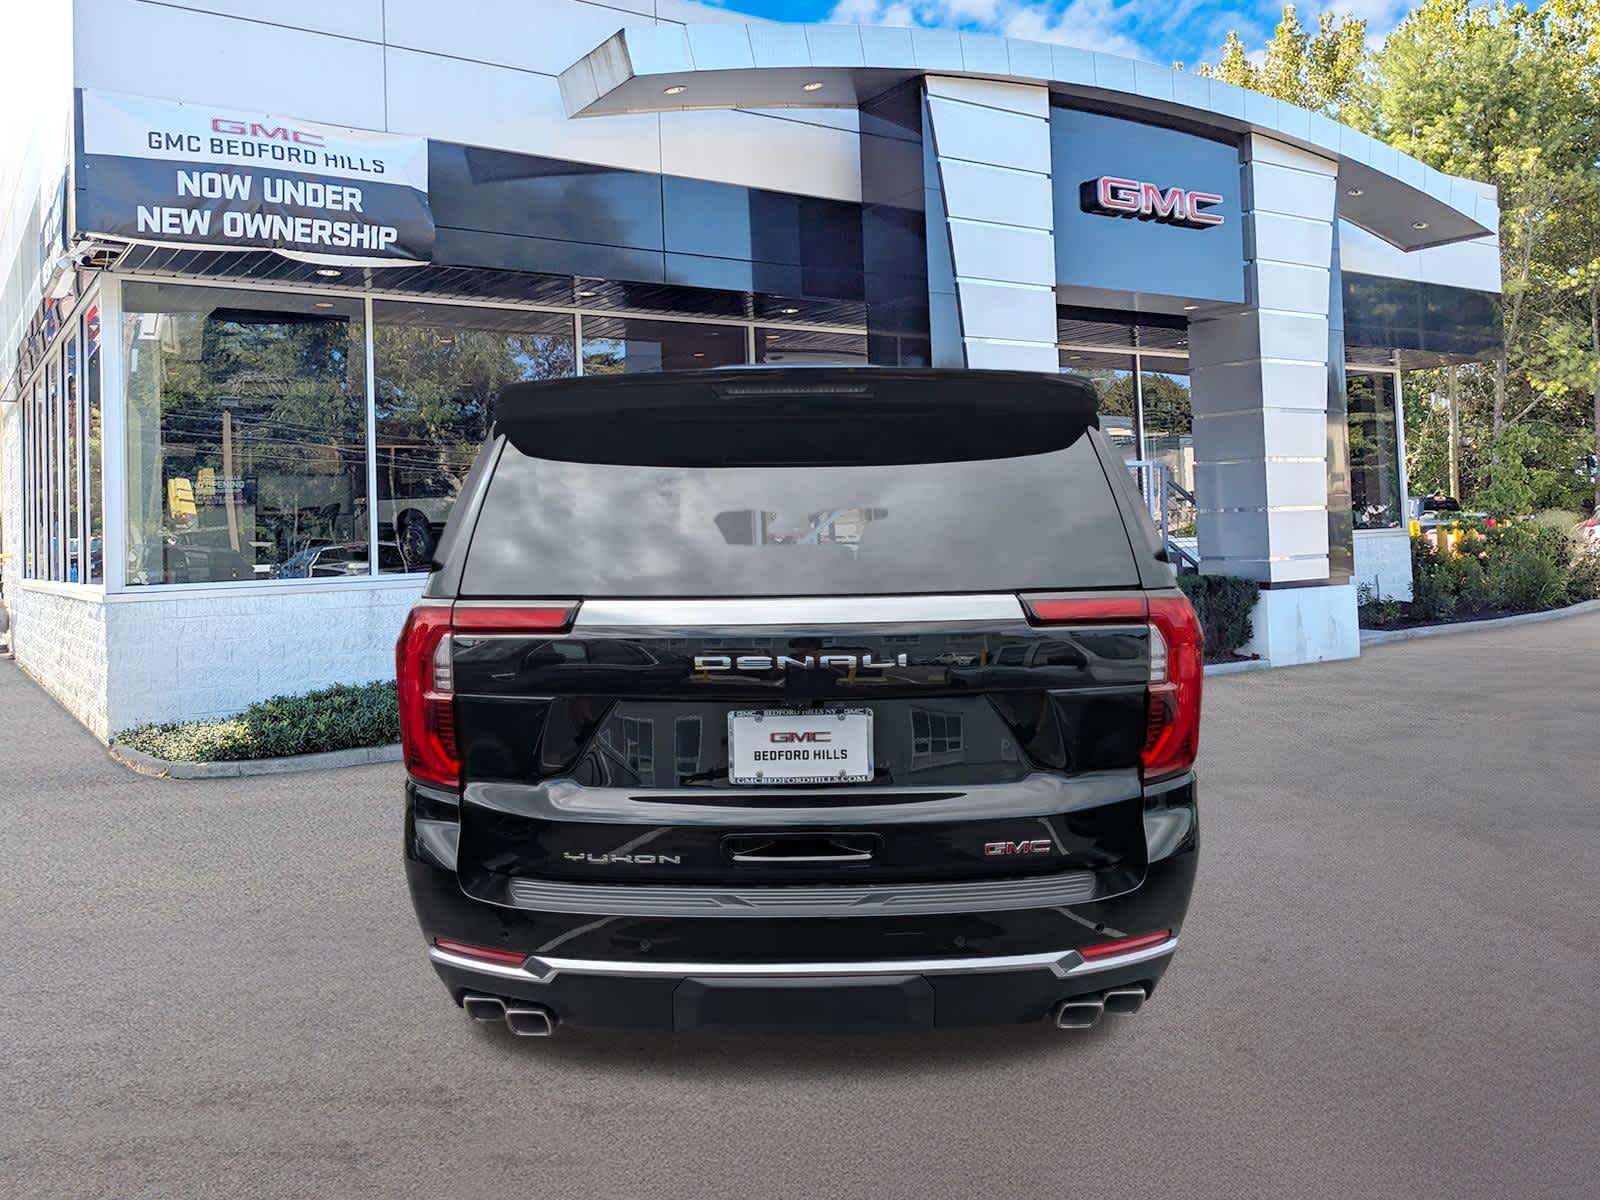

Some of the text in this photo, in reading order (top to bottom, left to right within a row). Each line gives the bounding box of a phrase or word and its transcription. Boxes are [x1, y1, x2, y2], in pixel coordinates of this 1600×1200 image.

[211, 118, 325, 148] GMC
[148, 131, 386, 174] GMC BEDFORD HILLS
[176, 170, 363, 213] NOW UNDER
[1095, 175, 1225, 225] GMC
[136, 205, 398, 250] NEW OWNERSHIP
[693, 653, 907, 671] DENALI
[769, 731, 831, 743] GMC
[753, 749, 848, 762] BEDFORD HILLS
[563, 851, 680, 864] YUKON
[984, 839, 1051, 856] GMC
